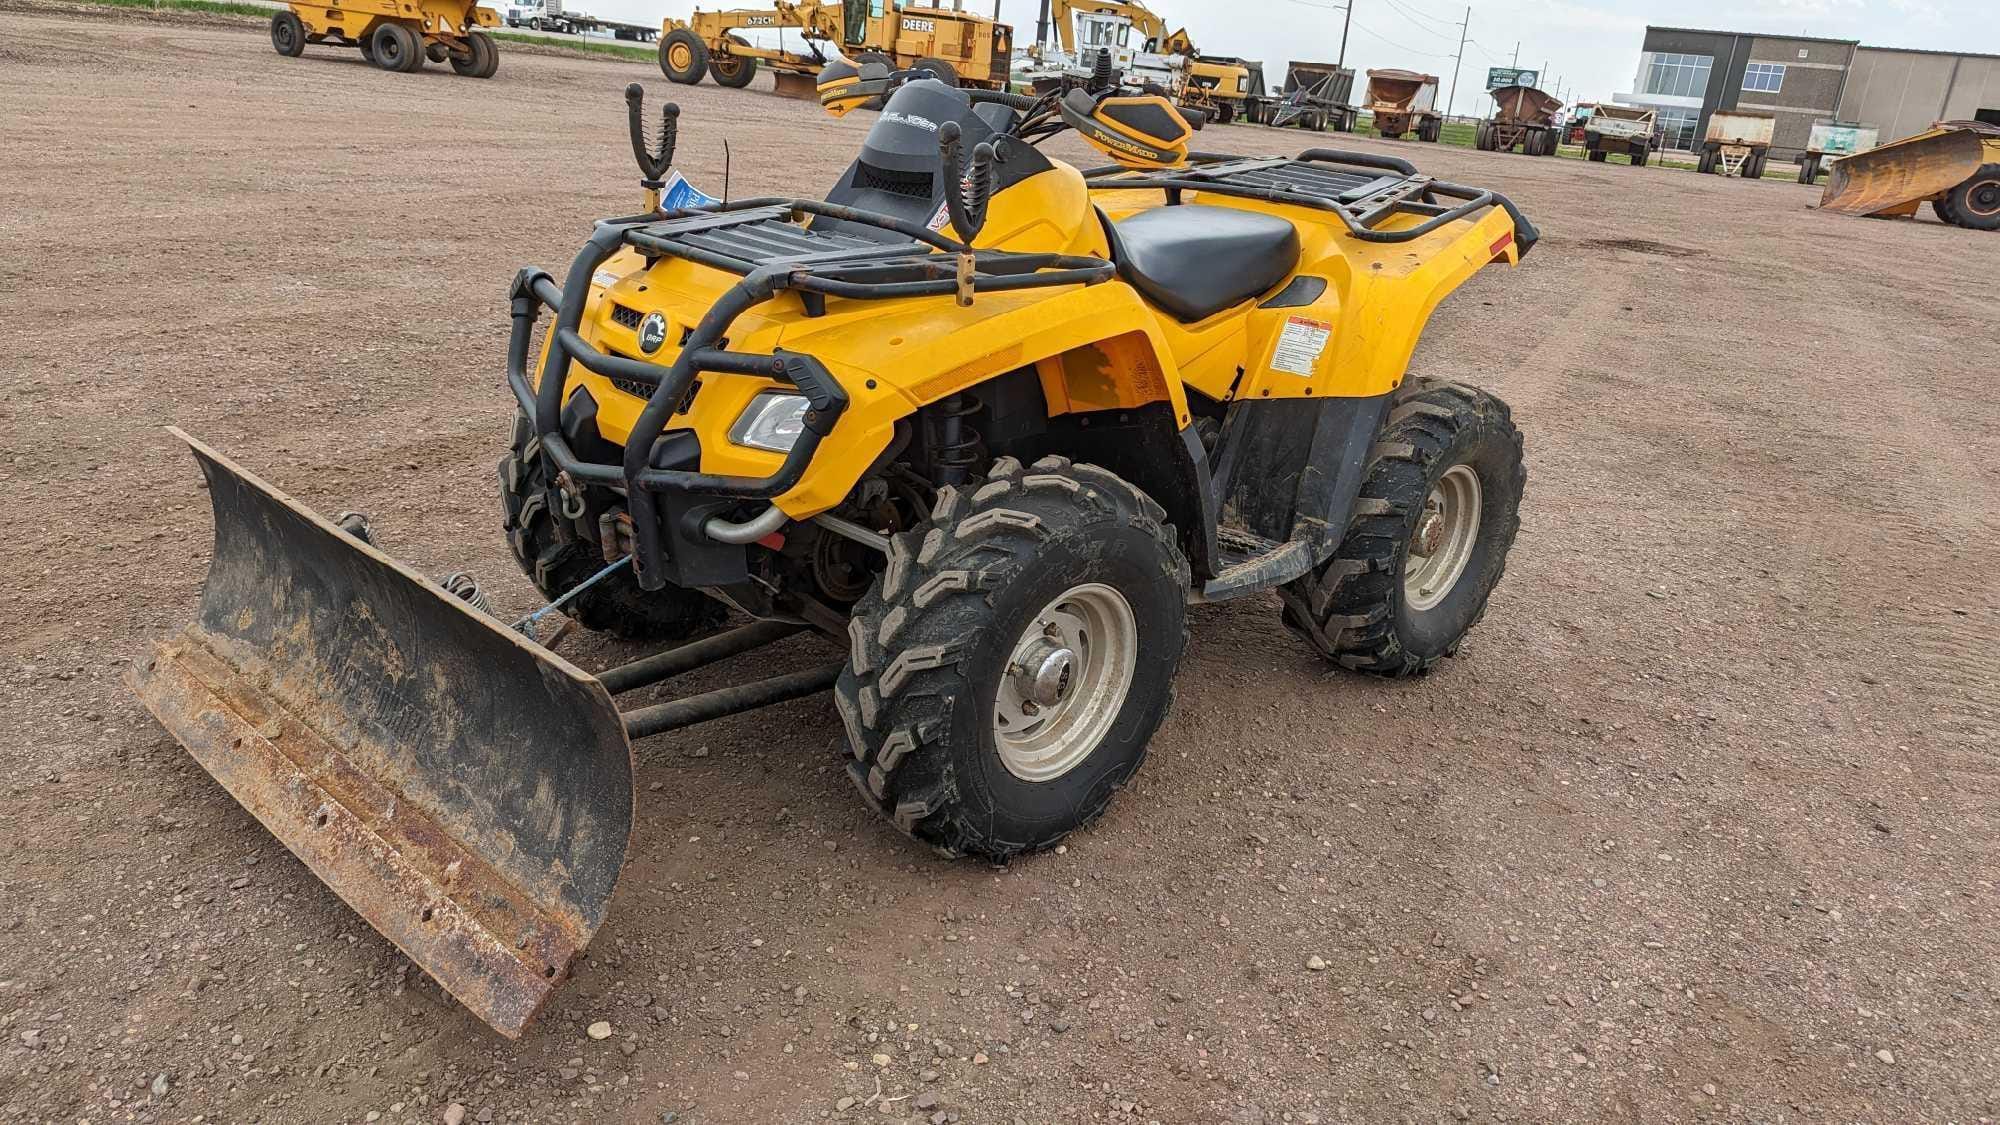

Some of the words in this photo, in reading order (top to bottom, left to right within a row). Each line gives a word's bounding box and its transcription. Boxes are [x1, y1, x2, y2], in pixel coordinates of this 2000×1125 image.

[747, 16, 775, 25] 672CH
[902, 19, 934, 32] DEERE
[646, 333, 662, 343] BRP
